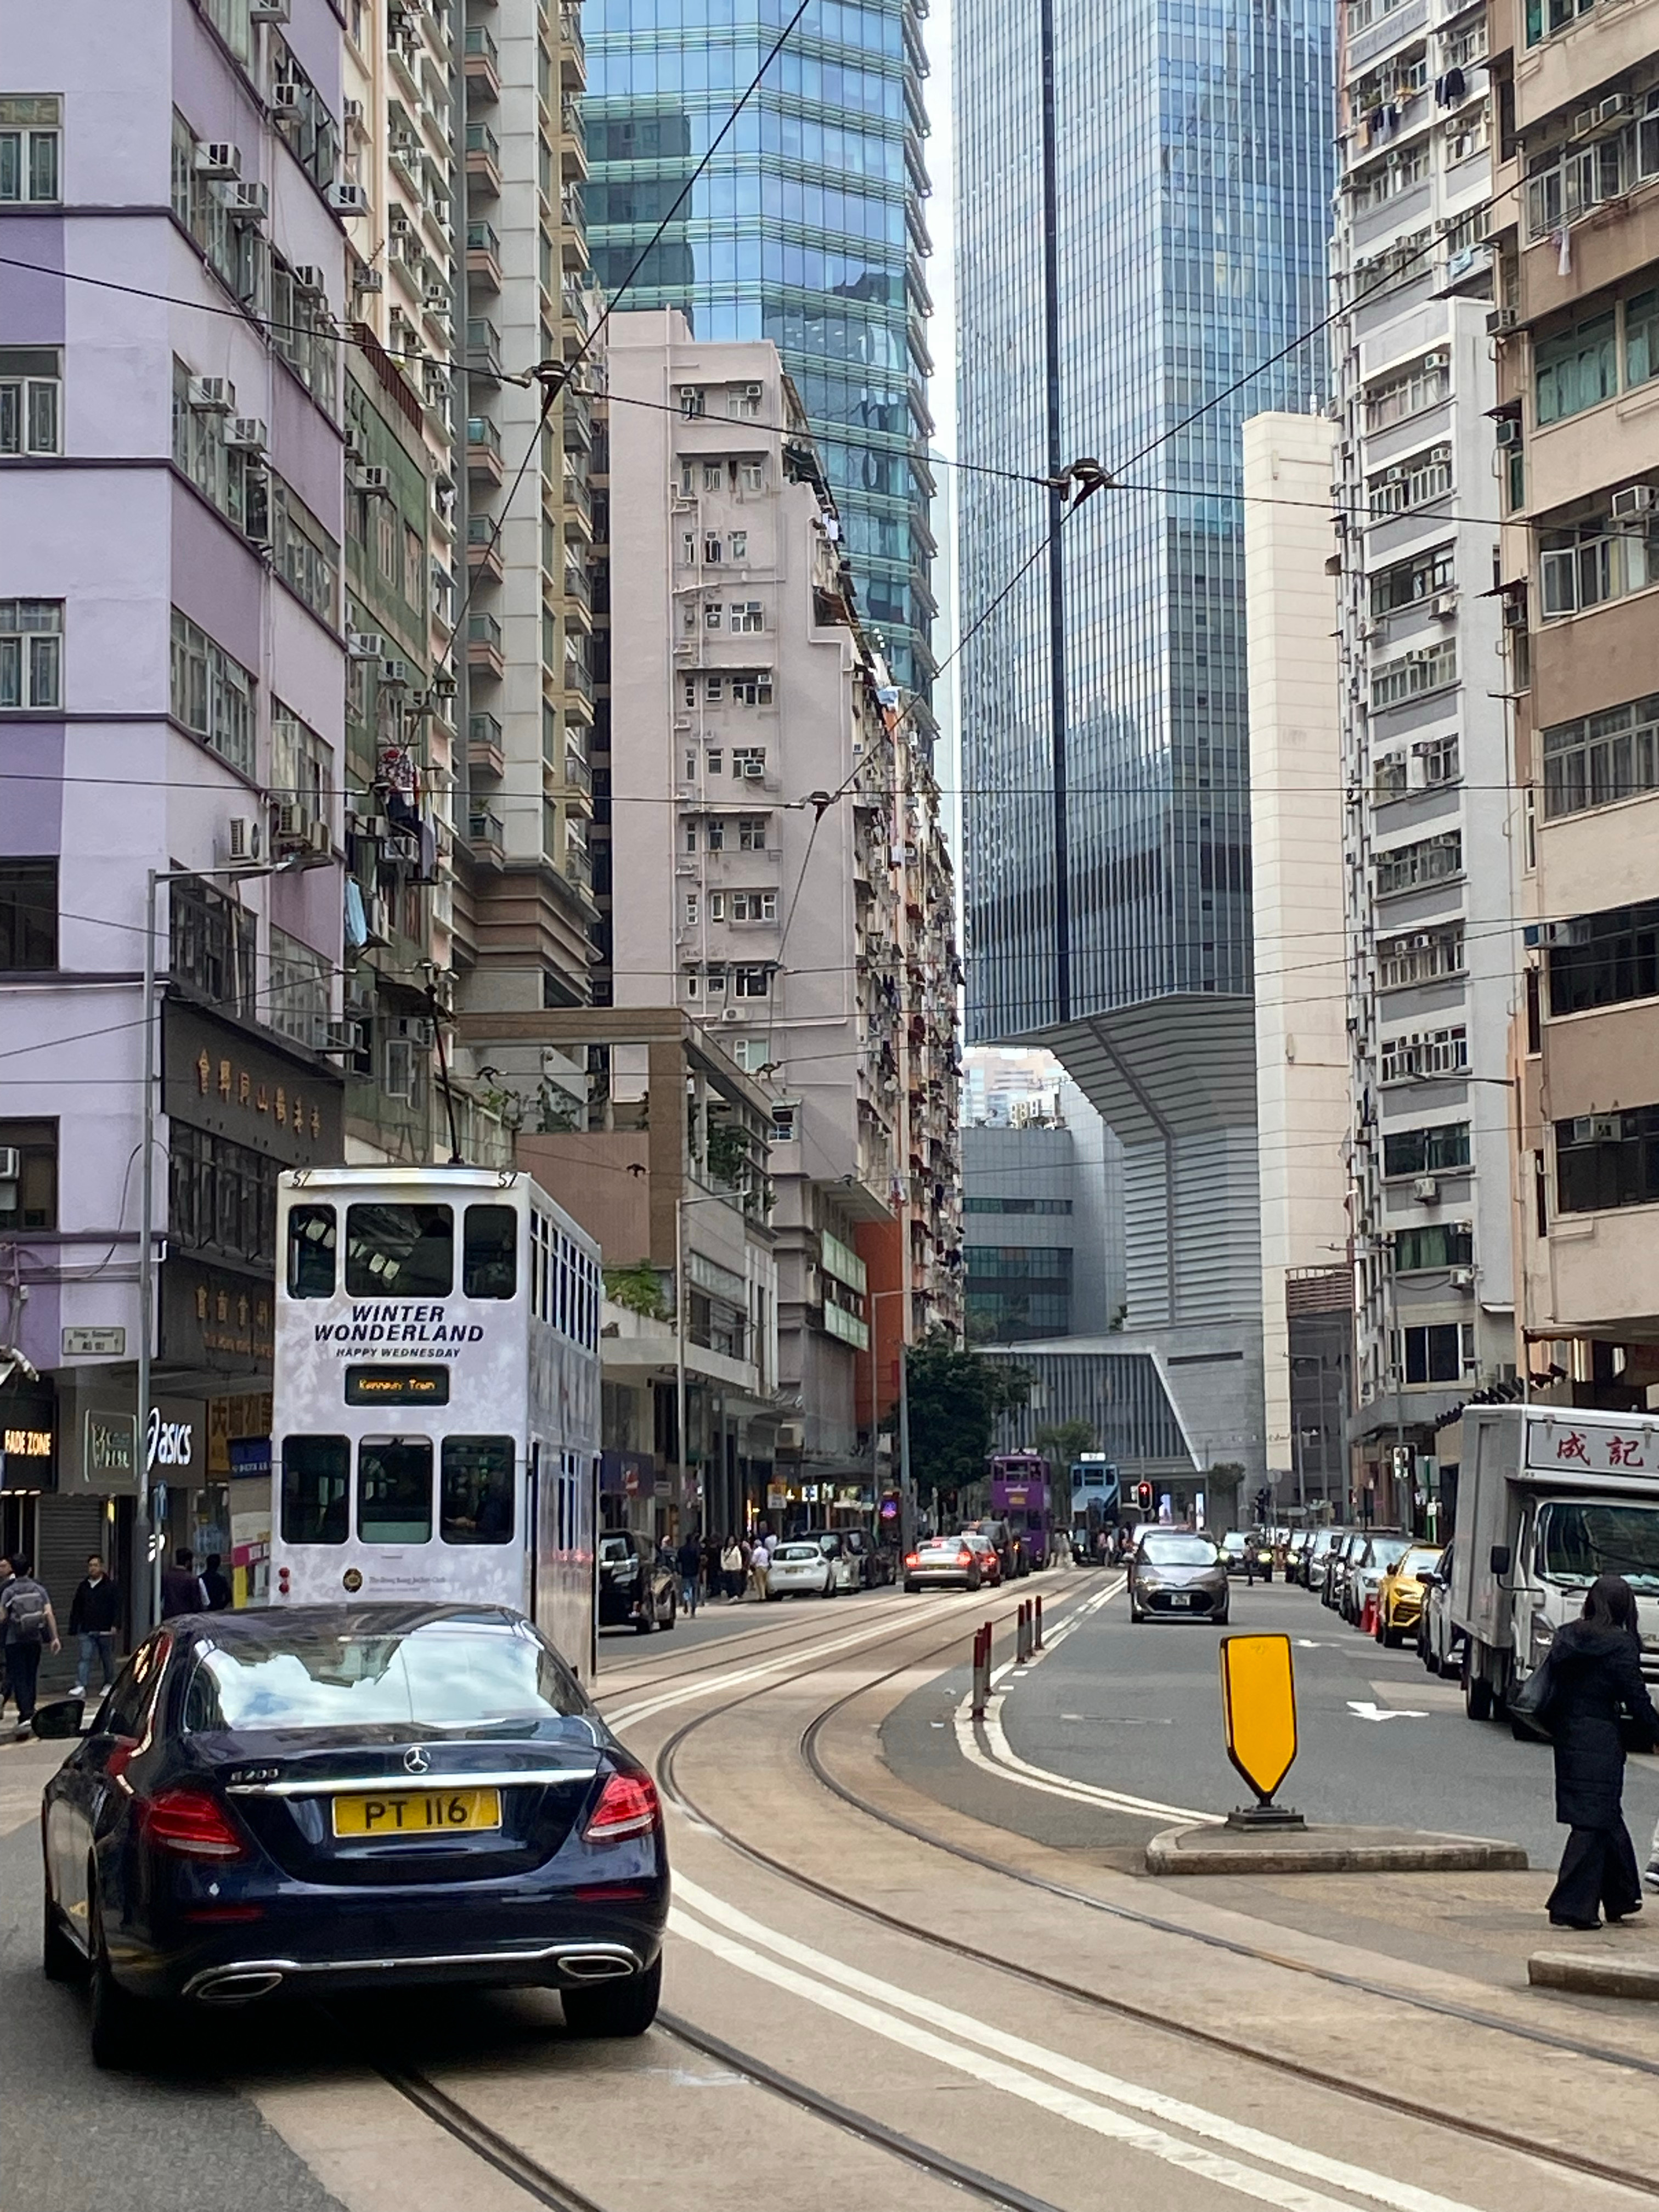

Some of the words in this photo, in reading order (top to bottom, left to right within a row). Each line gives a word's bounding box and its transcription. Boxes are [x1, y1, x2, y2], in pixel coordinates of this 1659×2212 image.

[292, 1171, 312, 1186] 57
[498, 1172, 517, 1188] 57
[352, 1305, 445, 1322] WINTER
[314, 1324, 484, 1342] WONDERLAND
[336, 1347, 377, 1358] HAPPY
[381, 1347, 460, 1358] WEDNESDAY
[27, 1431, 51, 1455] ZONE
[158, 1423, 192, 1465] asics
[1556, 1430, 1644, 1467] 成記
[364, 1801, 408, 1830] PT
[426, 1797, 468, 1826] 116
